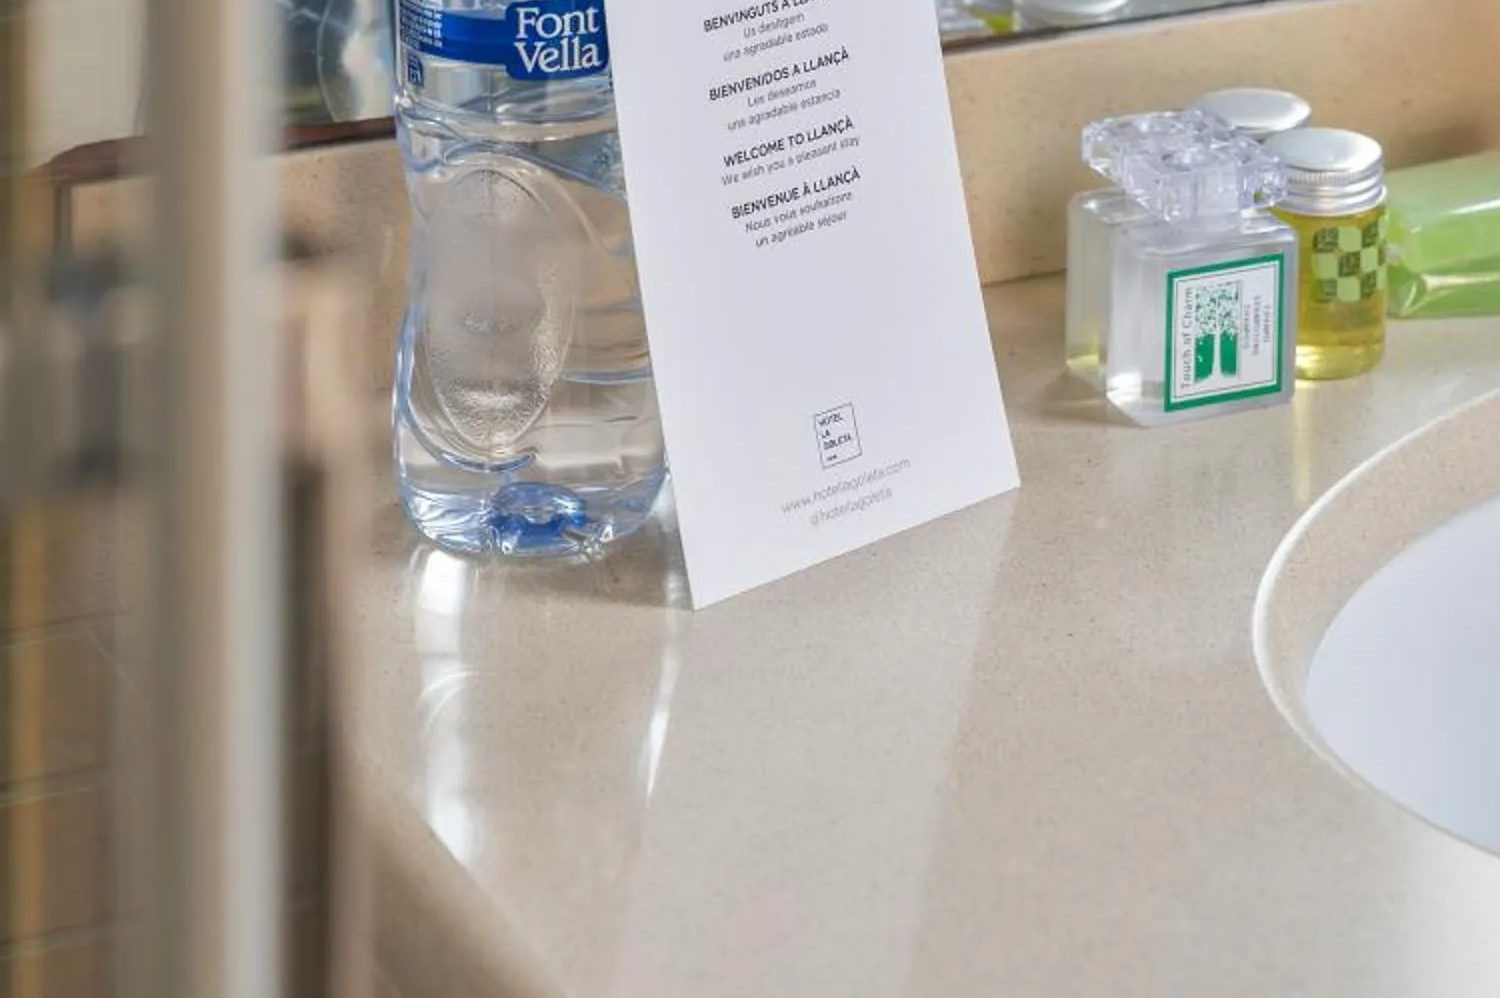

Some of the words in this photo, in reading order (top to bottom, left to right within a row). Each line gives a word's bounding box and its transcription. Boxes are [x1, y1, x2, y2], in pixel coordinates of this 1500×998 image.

[516, 5, 600, 39] Font
[743, 26, 757, 38] Us
[515, 37, 601, 74] Vella
[722, 48, 741, 62] una
[743, 32, 793, 58] agradable
[709, 66, 790, 101] BIENVENIDOS
[792, 64, 801, 77] A
[803, 45, 850, 73] LLANÇÀ
[727, 118, 746, 131] una
[749, 102, 799, 127] agradable
[800, 89, 841, 109] estancia
[723, 137, 785, 168] WELCOME
[787, 133, 805, 147] TO
[808, 115, 855, 142] LLANÇÀ
[721, 172, 740, 186] We
[741, 164, 765, 181] wish
[767, 159, 786, 175] you
[796, 141, 838, 166] pleasant
[731, 186, 800, 219] BIENVENUE
[813, 165, 862, 193] LLANÇÀ
[745, 216, 772, 234] Nous
[773, 209, 798, 224] vous
[800, 191, 853, 215] souhaitons
[755, 235, 769, 248] un
